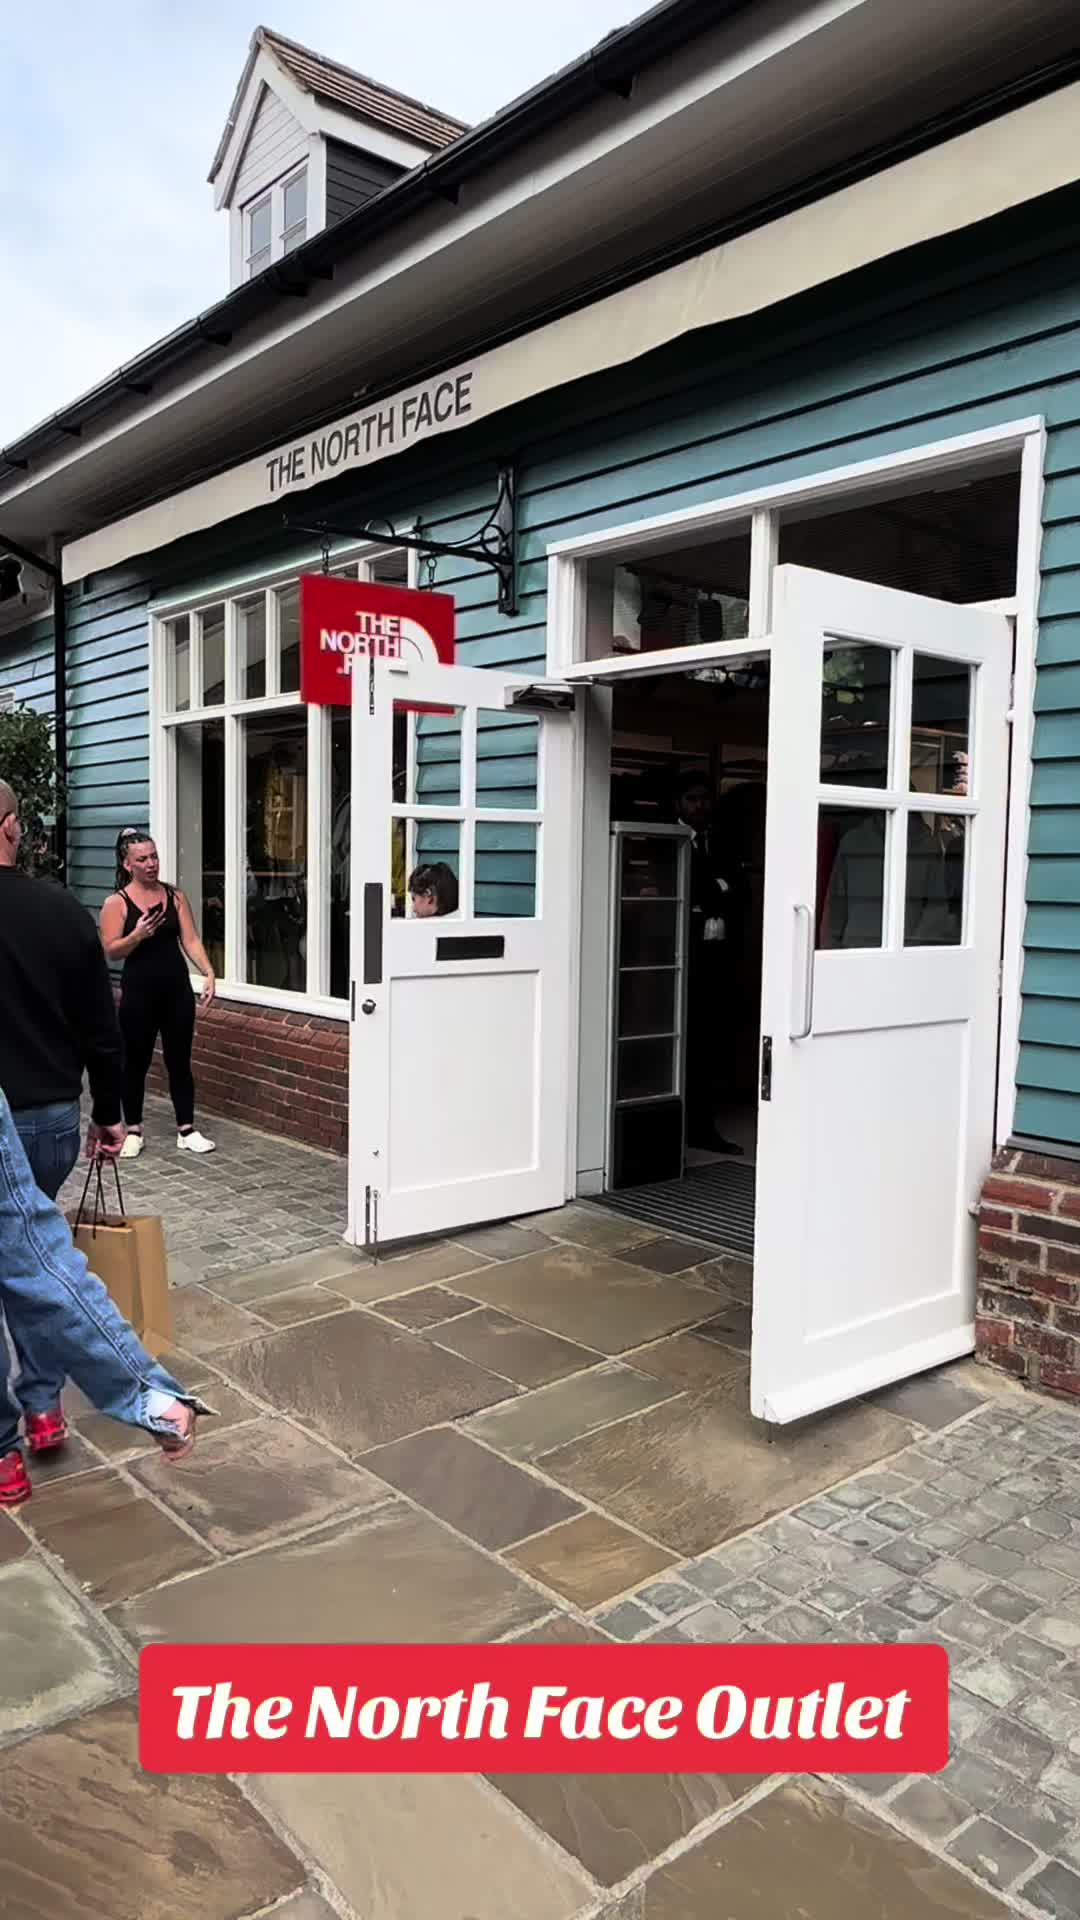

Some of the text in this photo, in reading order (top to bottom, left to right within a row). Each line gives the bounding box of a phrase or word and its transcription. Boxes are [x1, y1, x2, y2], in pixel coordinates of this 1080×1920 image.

[266, 372, 473, 492] THE NORTH FACE
[355, 610, 400, 637] THE
[320, 628, 400, 659] NORTH
